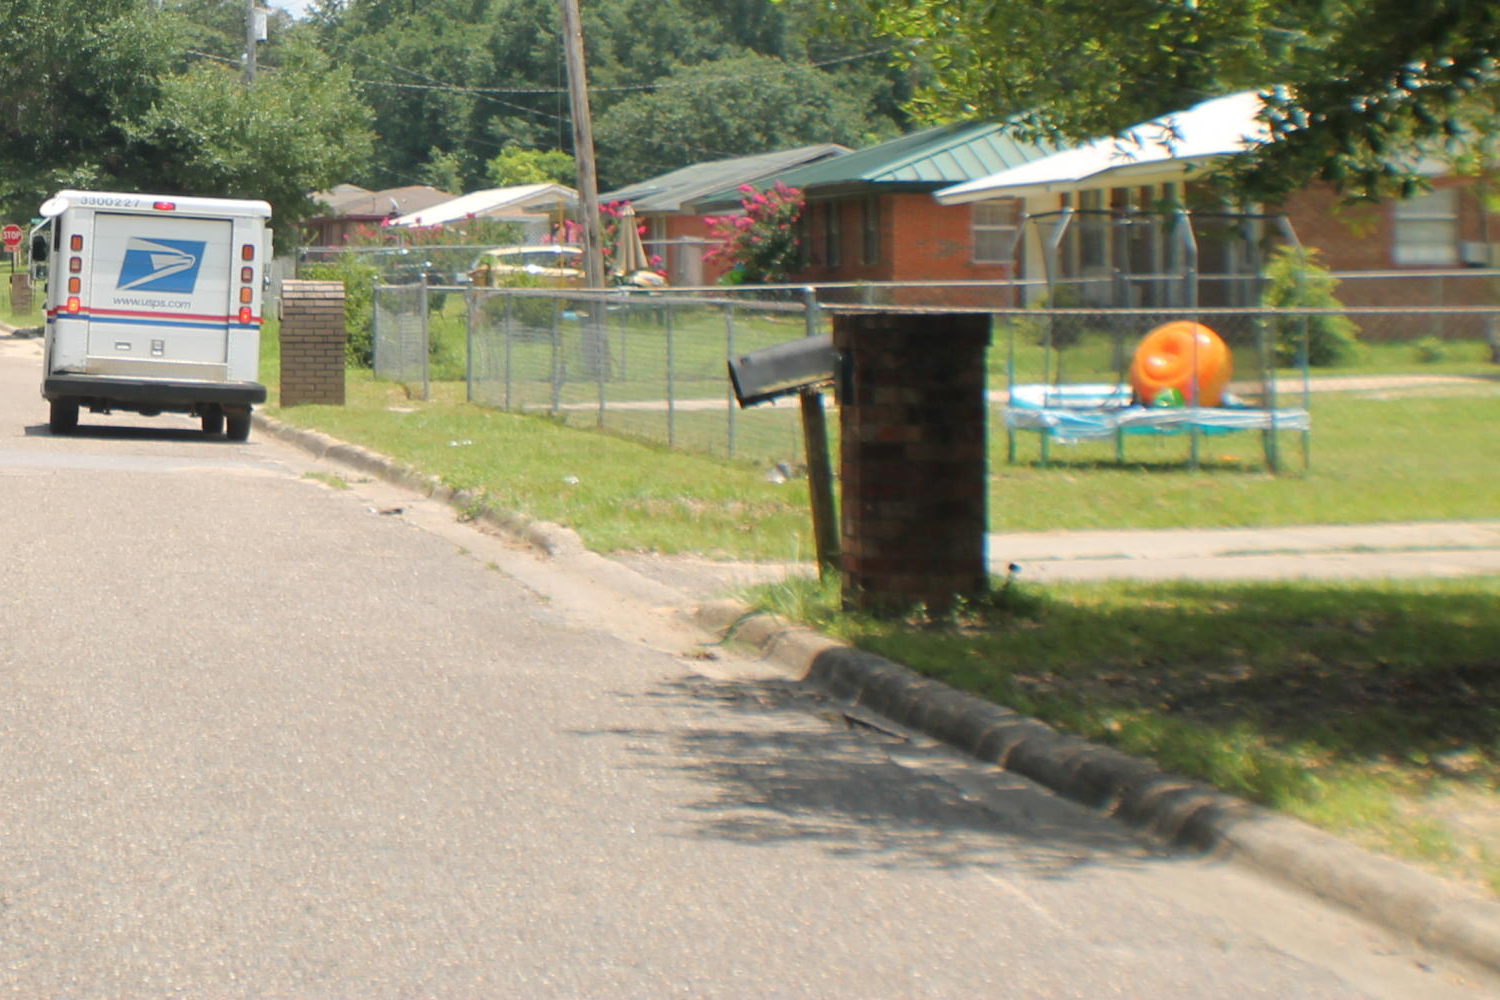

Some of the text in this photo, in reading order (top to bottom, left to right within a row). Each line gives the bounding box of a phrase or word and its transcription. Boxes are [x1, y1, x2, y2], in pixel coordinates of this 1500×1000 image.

[80, 196, 141, 208] 3300227
[3, 231, 22, 240] STOP
[113, 297, 192, 309] www.usps.com
